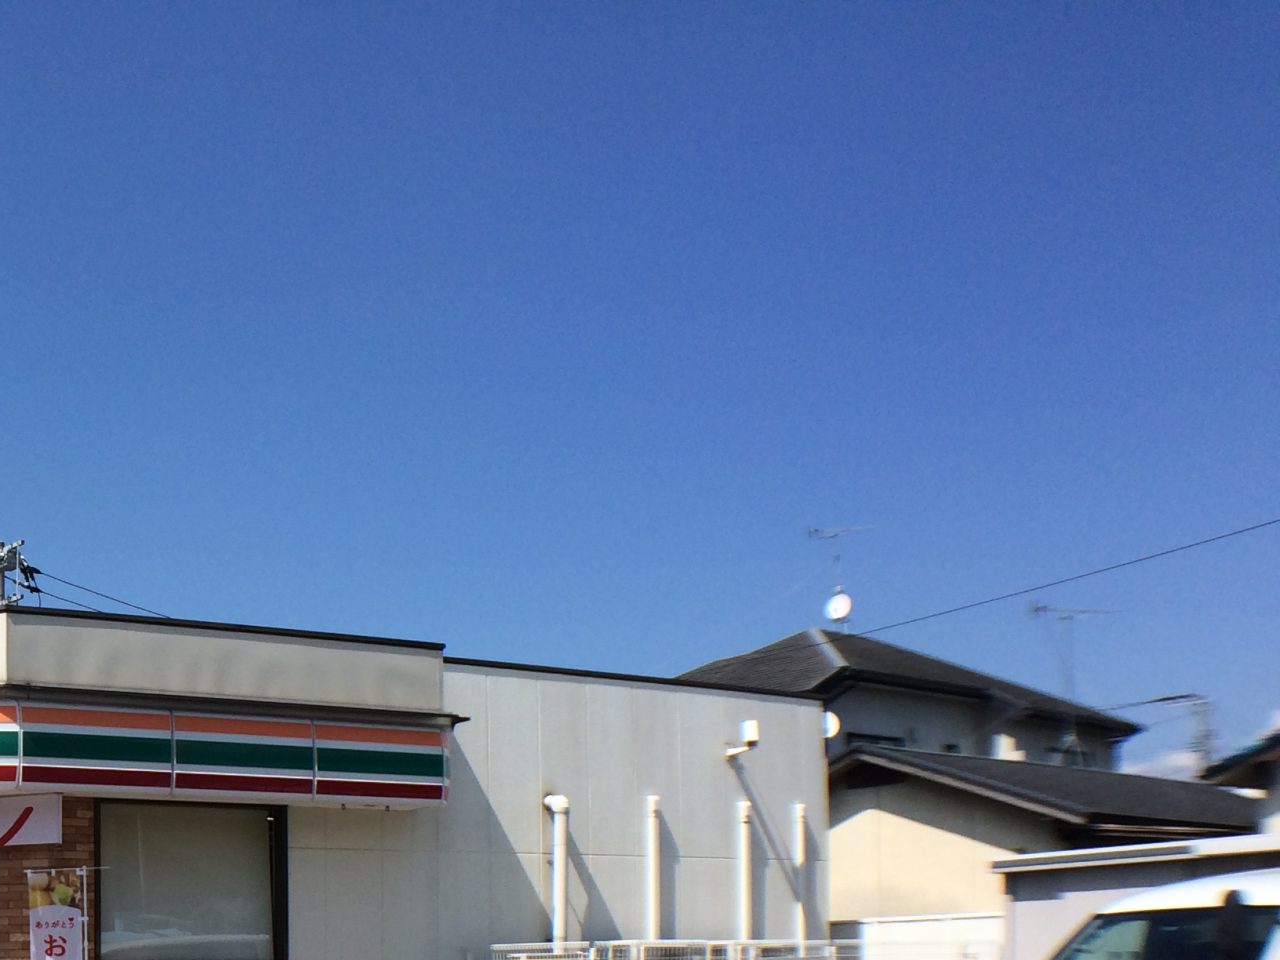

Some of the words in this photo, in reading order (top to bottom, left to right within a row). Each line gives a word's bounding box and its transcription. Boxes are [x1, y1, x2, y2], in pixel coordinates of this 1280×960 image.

[35, 917, 75, 929] ありがとう
